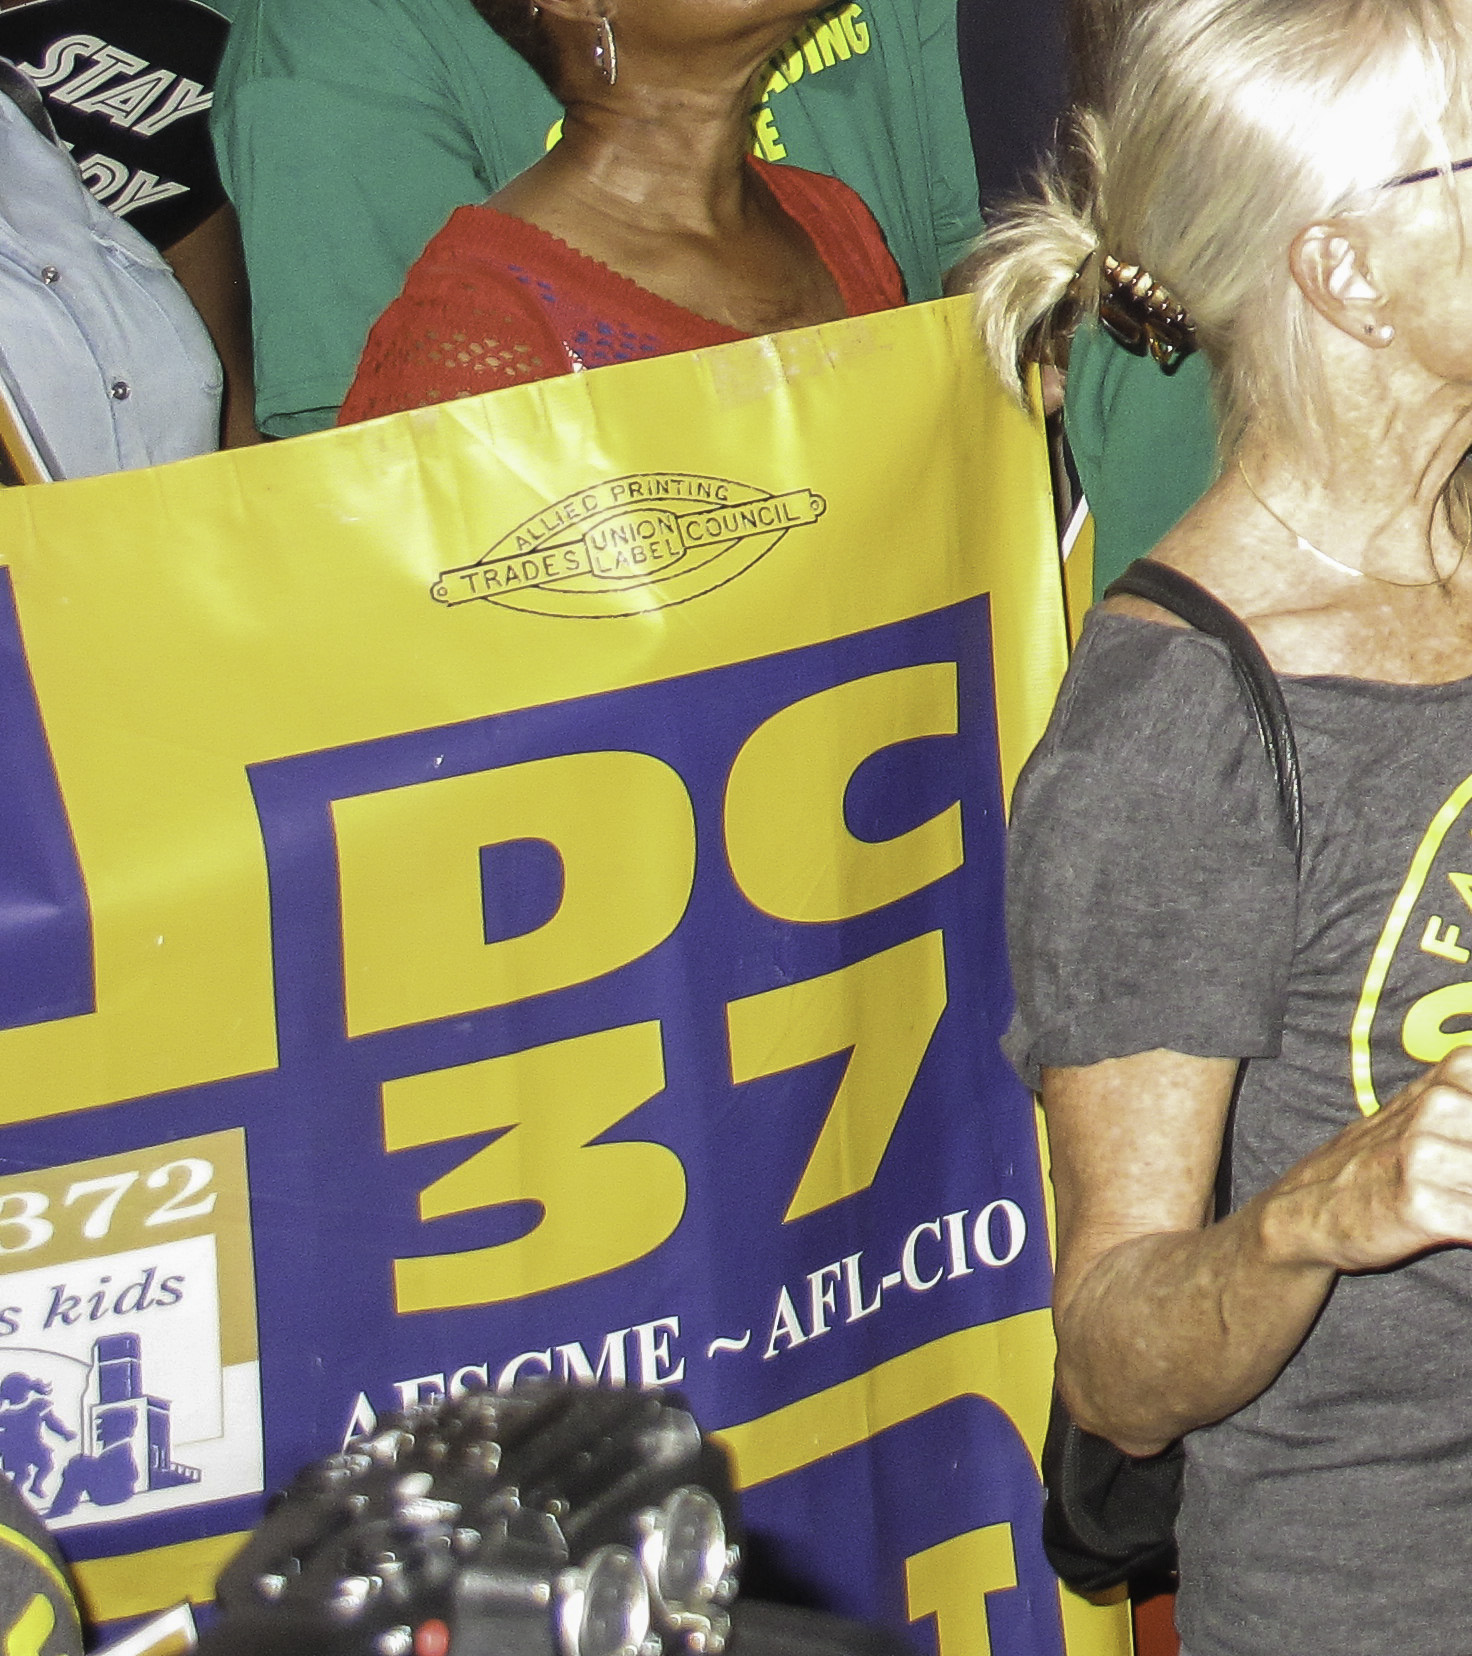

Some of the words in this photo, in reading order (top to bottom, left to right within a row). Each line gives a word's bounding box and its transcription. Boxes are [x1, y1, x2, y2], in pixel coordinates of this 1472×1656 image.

[17, 33, 215, 139] STAY
[460, 550, 581, 594] TRADES
[685, 503, 801, 541] COUNCIL
[515, 495, 599, 553] ALLIED
[612, 479, 729, 503] PRINTING
[591, 515, 676, 551] UNION
[593, 538, 682, 574] LABEL
[329, 660, 966, 1038] DC
[381, 929, 950, 1315] 37
[0, 1157, 218, 1256] 372
[43, 1266, 186, 1330] kids
[763, 1198, 1027, 1360] AFL-CIO
